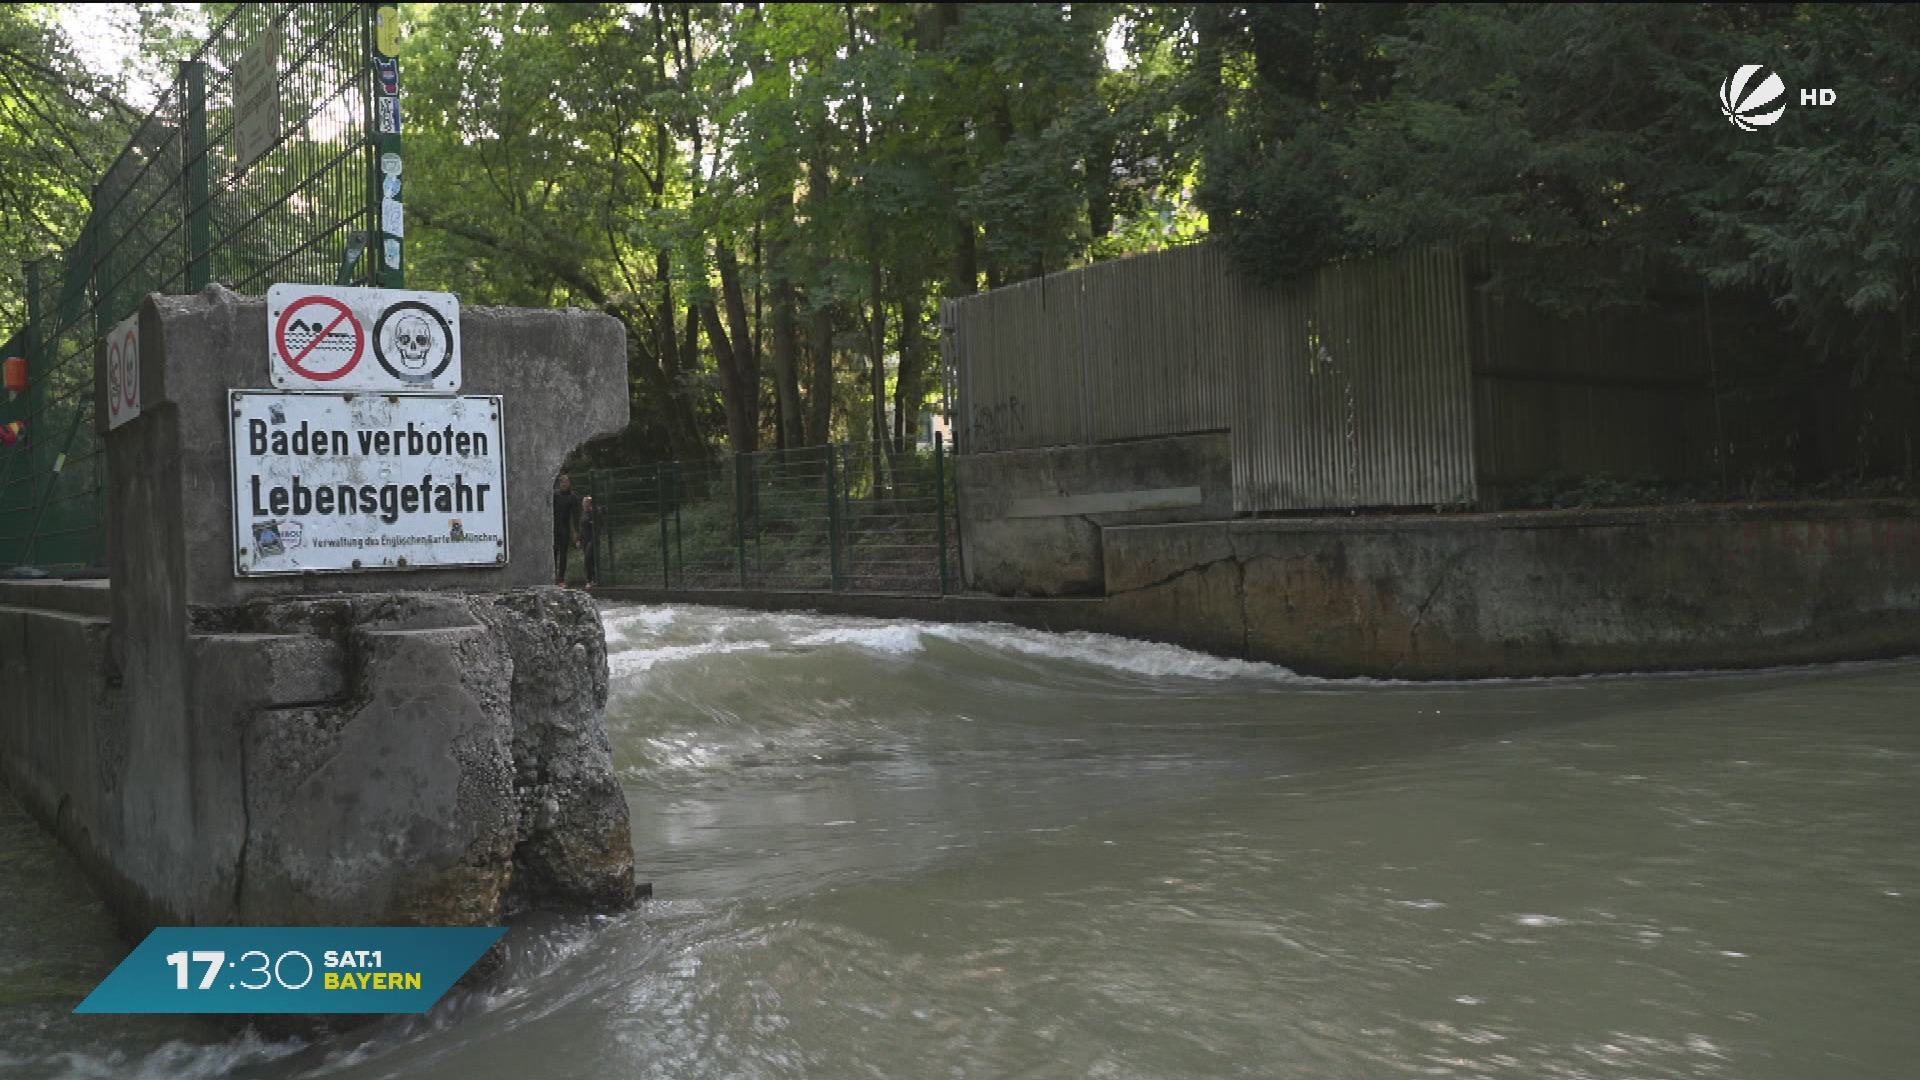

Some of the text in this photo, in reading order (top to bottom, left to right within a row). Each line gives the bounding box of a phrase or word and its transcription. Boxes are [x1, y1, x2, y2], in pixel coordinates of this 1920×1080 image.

[249, 418, 488, 456] Baden verboten
[251, 474, 490, 524] Lebensgefahr
[312, 536, 364, 549] Verwaltung
[365, 536, 380, 546] des
[381, 533, 427, 547] Englischen
